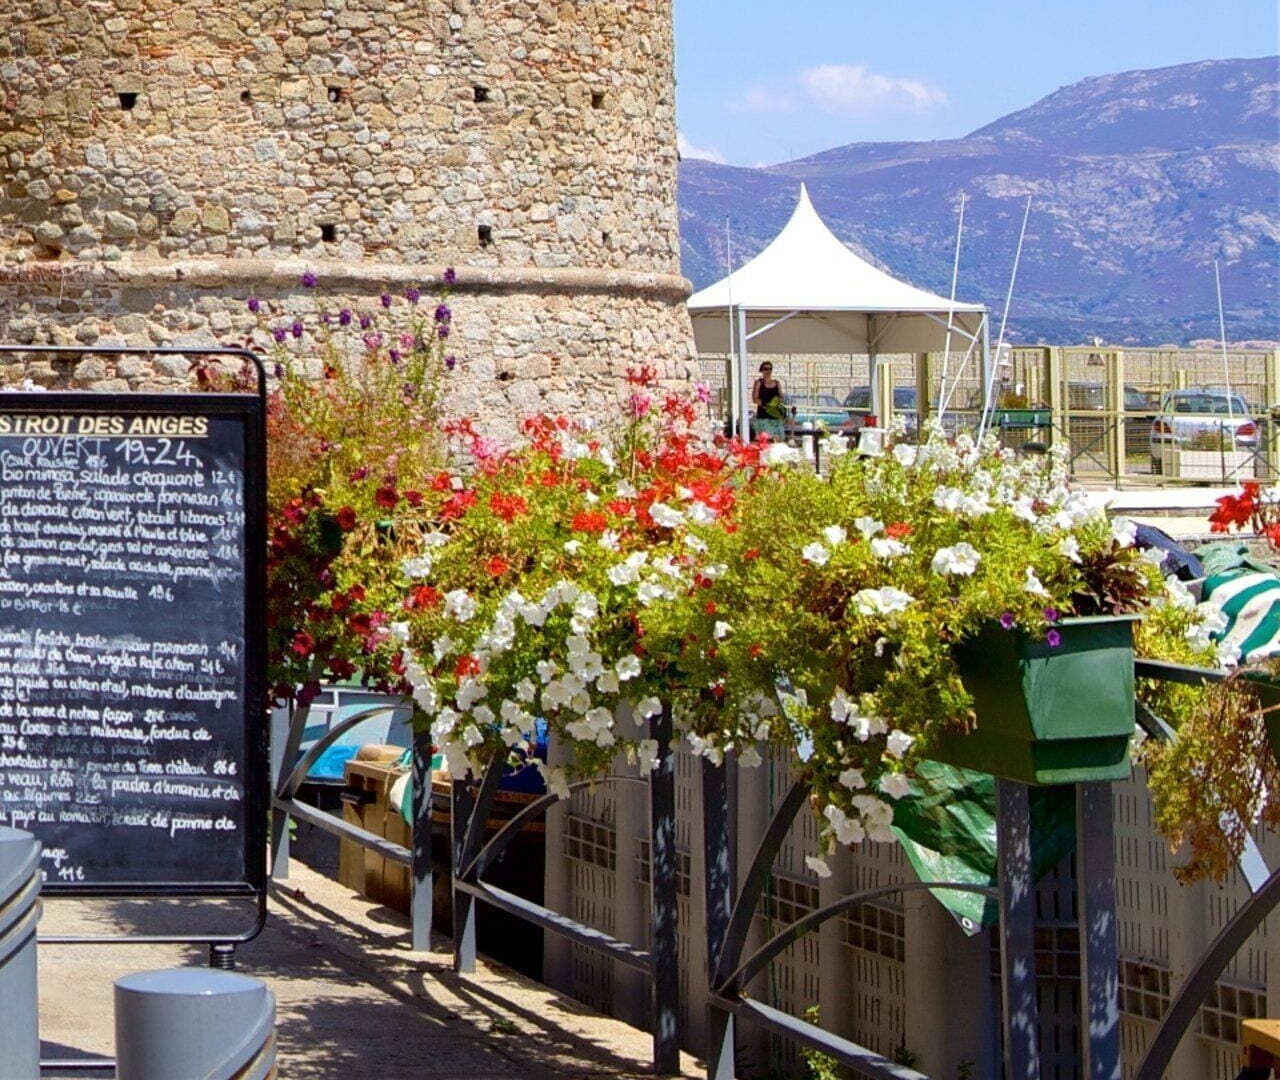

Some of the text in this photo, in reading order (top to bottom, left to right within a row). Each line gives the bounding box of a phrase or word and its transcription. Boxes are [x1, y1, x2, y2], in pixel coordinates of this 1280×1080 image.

[78, 416, 125, 434] DES
[129, 416, 208, 434] ANGES
[23, 436, 110, 459] OUVERT
[2, 502, 19, 516] de
[151, 813, 168, 828] de
[215, 816, 236, 828] de
